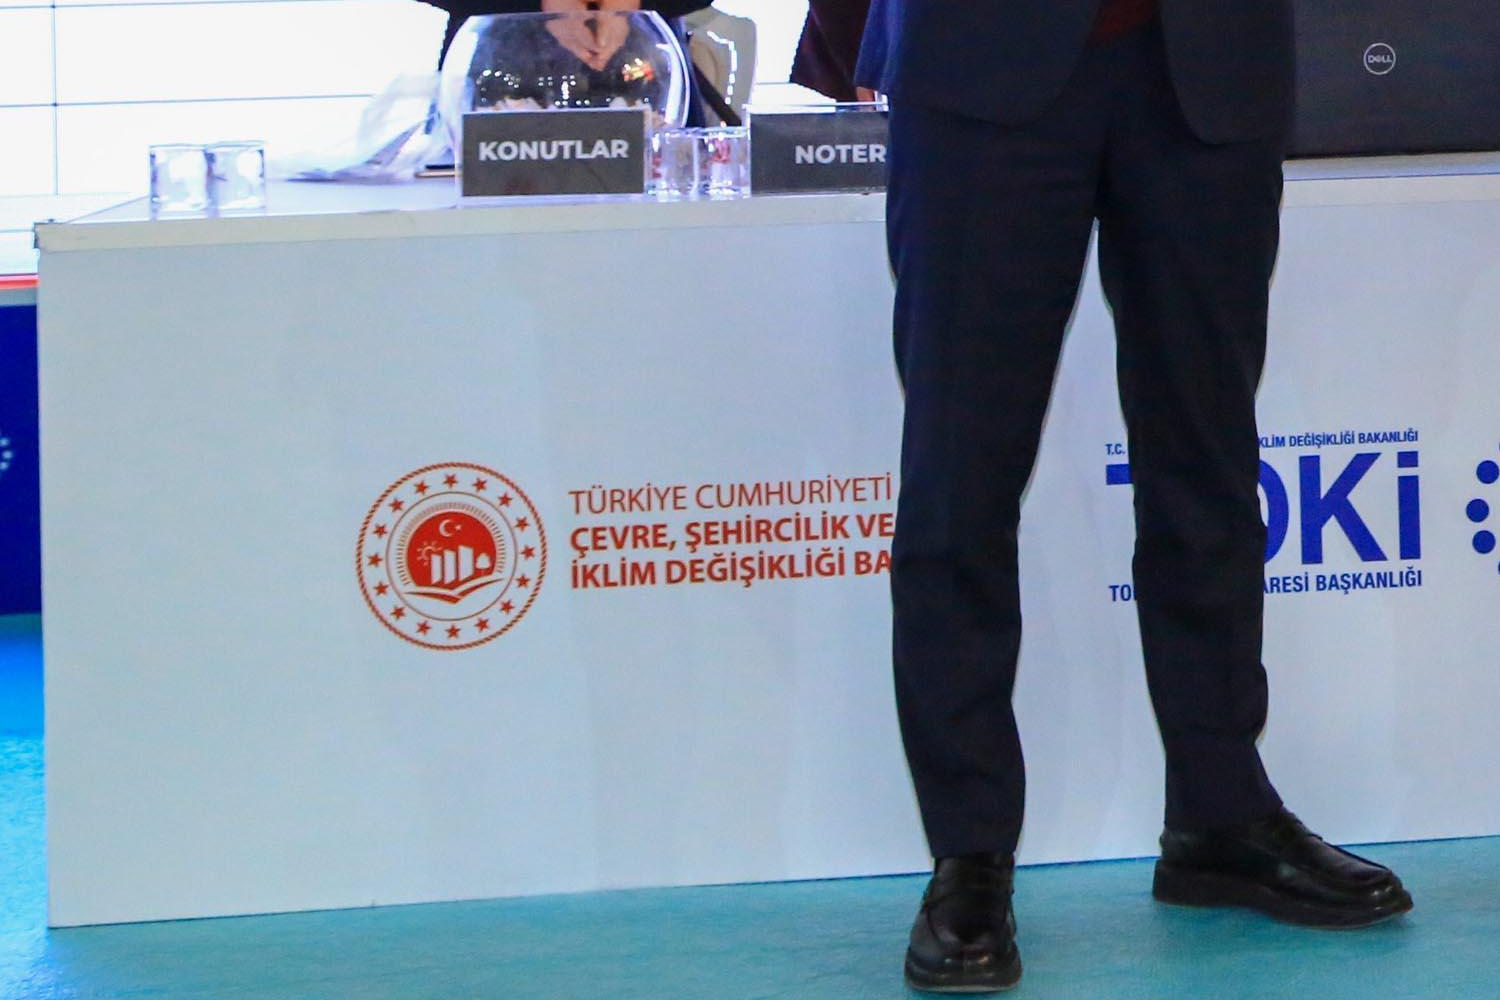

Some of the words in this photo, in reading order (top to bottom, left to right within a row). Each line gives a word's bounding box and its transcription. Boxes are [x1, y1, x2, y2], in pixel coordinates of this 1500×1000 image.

[478, 139, 629, 161] KONUTLAR
[795, 143, 887, 164] NOTER
[1105, 444, 1126, 456] T.C.
[1259, 434, 1286, 449] KLİM
[1289, 430, 1355, 449] DEĞİŞİKLİĞİ
[1358, 428, 1419, 445] BAKANLIĞI
[568, 482, 688, 515] TÜRKİYE
[695, 472, 892, 509] CUMHURİYETİ
[570, 523, 677, 559] ÇEVRE,
[685, 510, 850, 553] ŞEHİRCİLİK
[856, 513, 895, 538] VE
[572, 556, 656, 589] İKLİM
[665, 546, 846, 588] DEĞİŞİKLİĞİ
[1316, 566, 1422, 595] BAŞKANLIĞI
